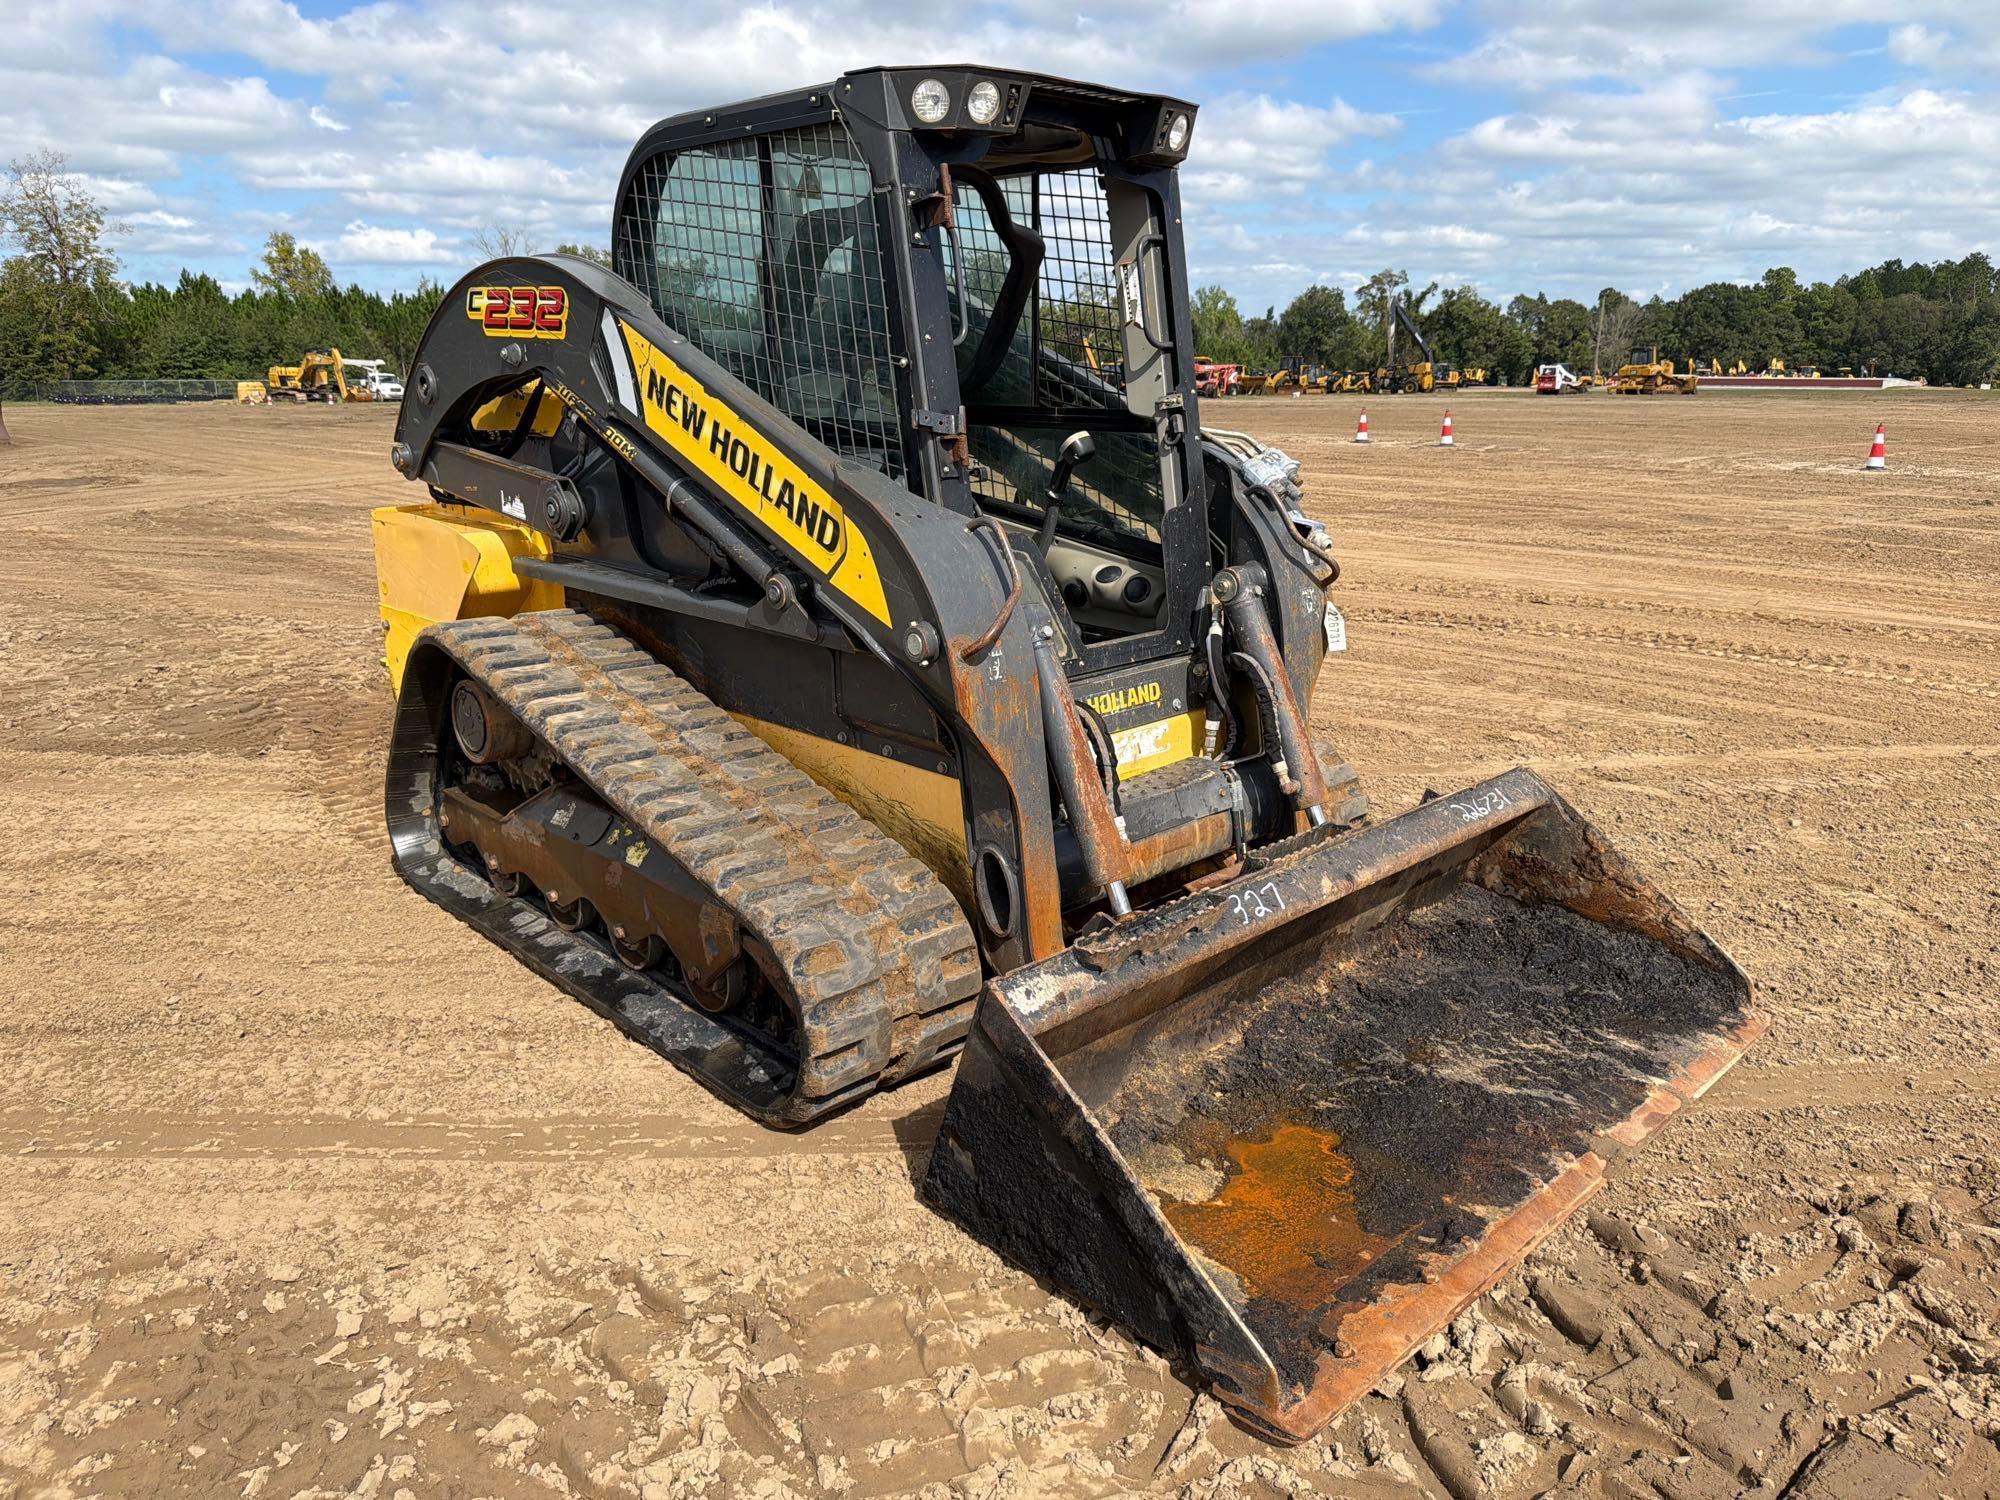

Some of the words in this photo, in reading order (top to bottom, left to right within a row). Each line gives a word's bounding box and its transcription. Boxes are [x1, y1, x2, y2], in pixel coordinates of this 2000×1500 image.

[647, 368, 707, 441] NEW
[709, 419, 841, 554] HOLLAND
[1327, 608, 1341, 644] 226731
[1087, 682, 1162, 714] HOLLAND
[1450, 787, 1511, 821] 226731
[1228, 882, 1286, 925] 327
